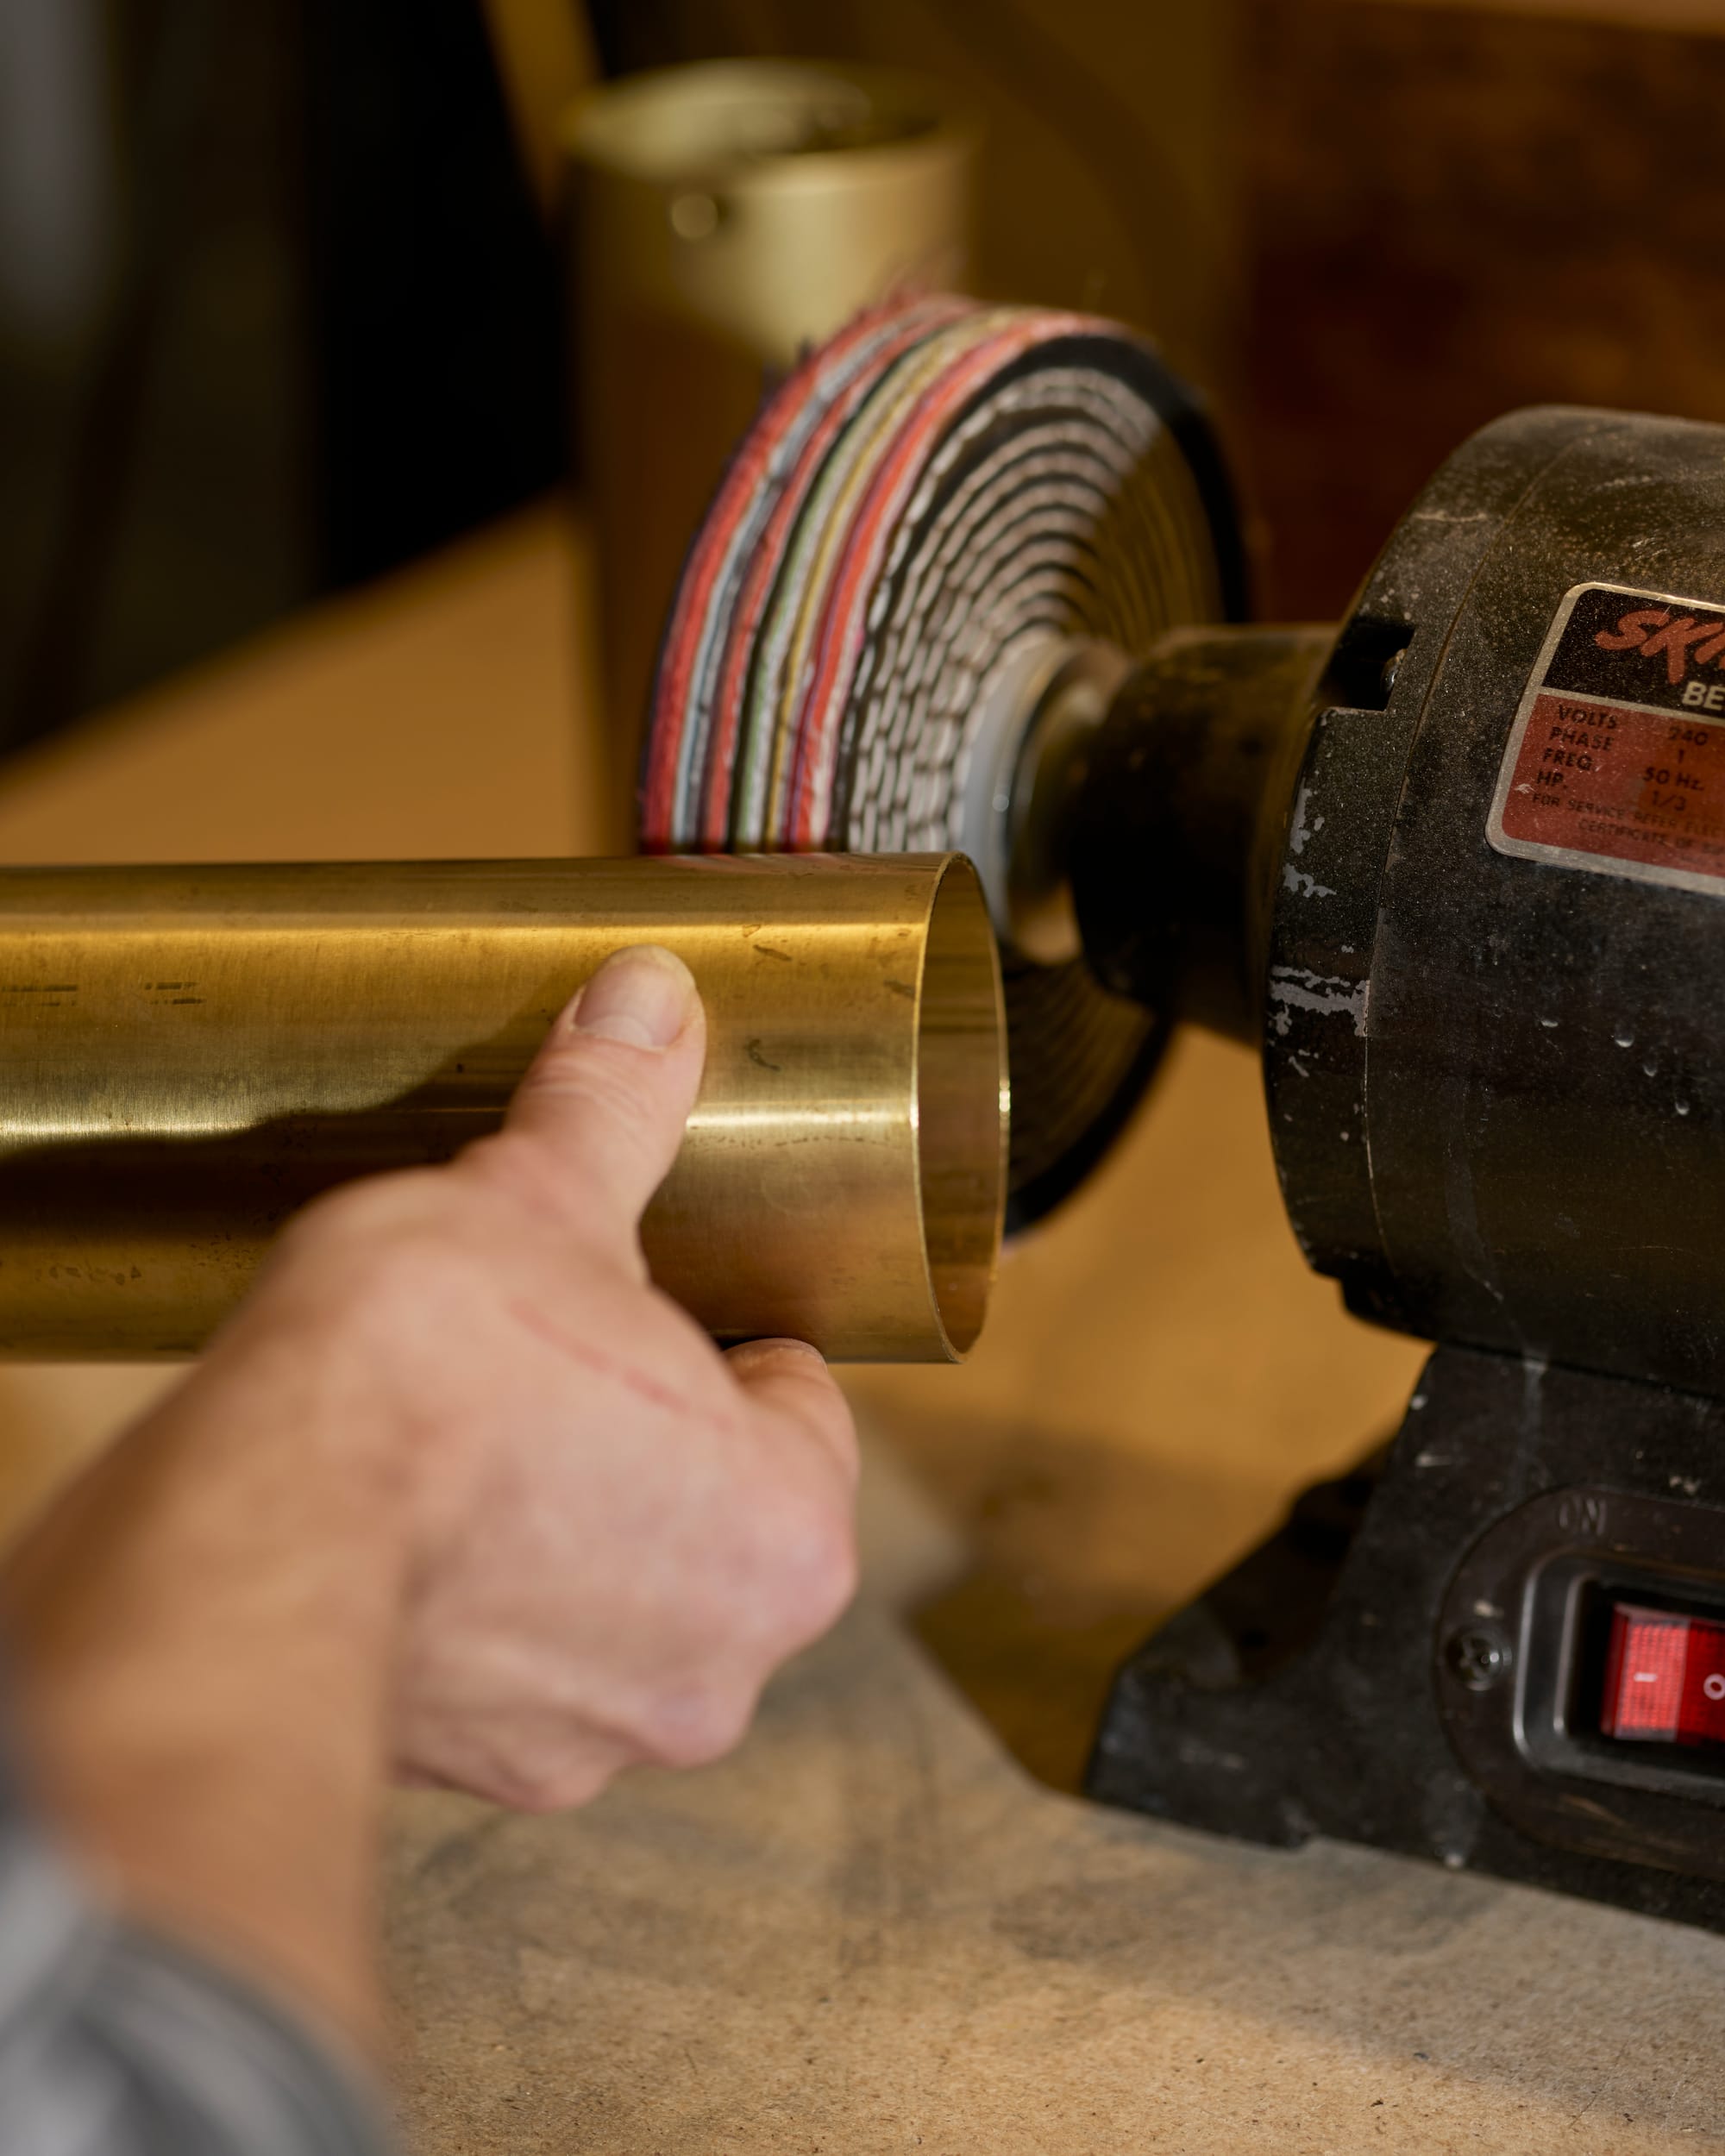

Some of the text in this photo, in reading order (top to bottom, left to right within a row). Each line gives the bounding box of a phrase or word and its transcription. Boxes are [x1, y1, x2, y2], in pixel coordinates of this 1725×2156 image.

[1558, 704, 1709, 746] VOLTS 240
[1549, 726, 1615, 751] PHASE
[1642, 766, 1671, 785] 50
[1532, 793, 1560, 807] FOR
[1568, 799, 1625, 819] SERVICE
[1651, 790, 1686, 812] 1/3
[1558, 1495, 1607, 1535] ON
